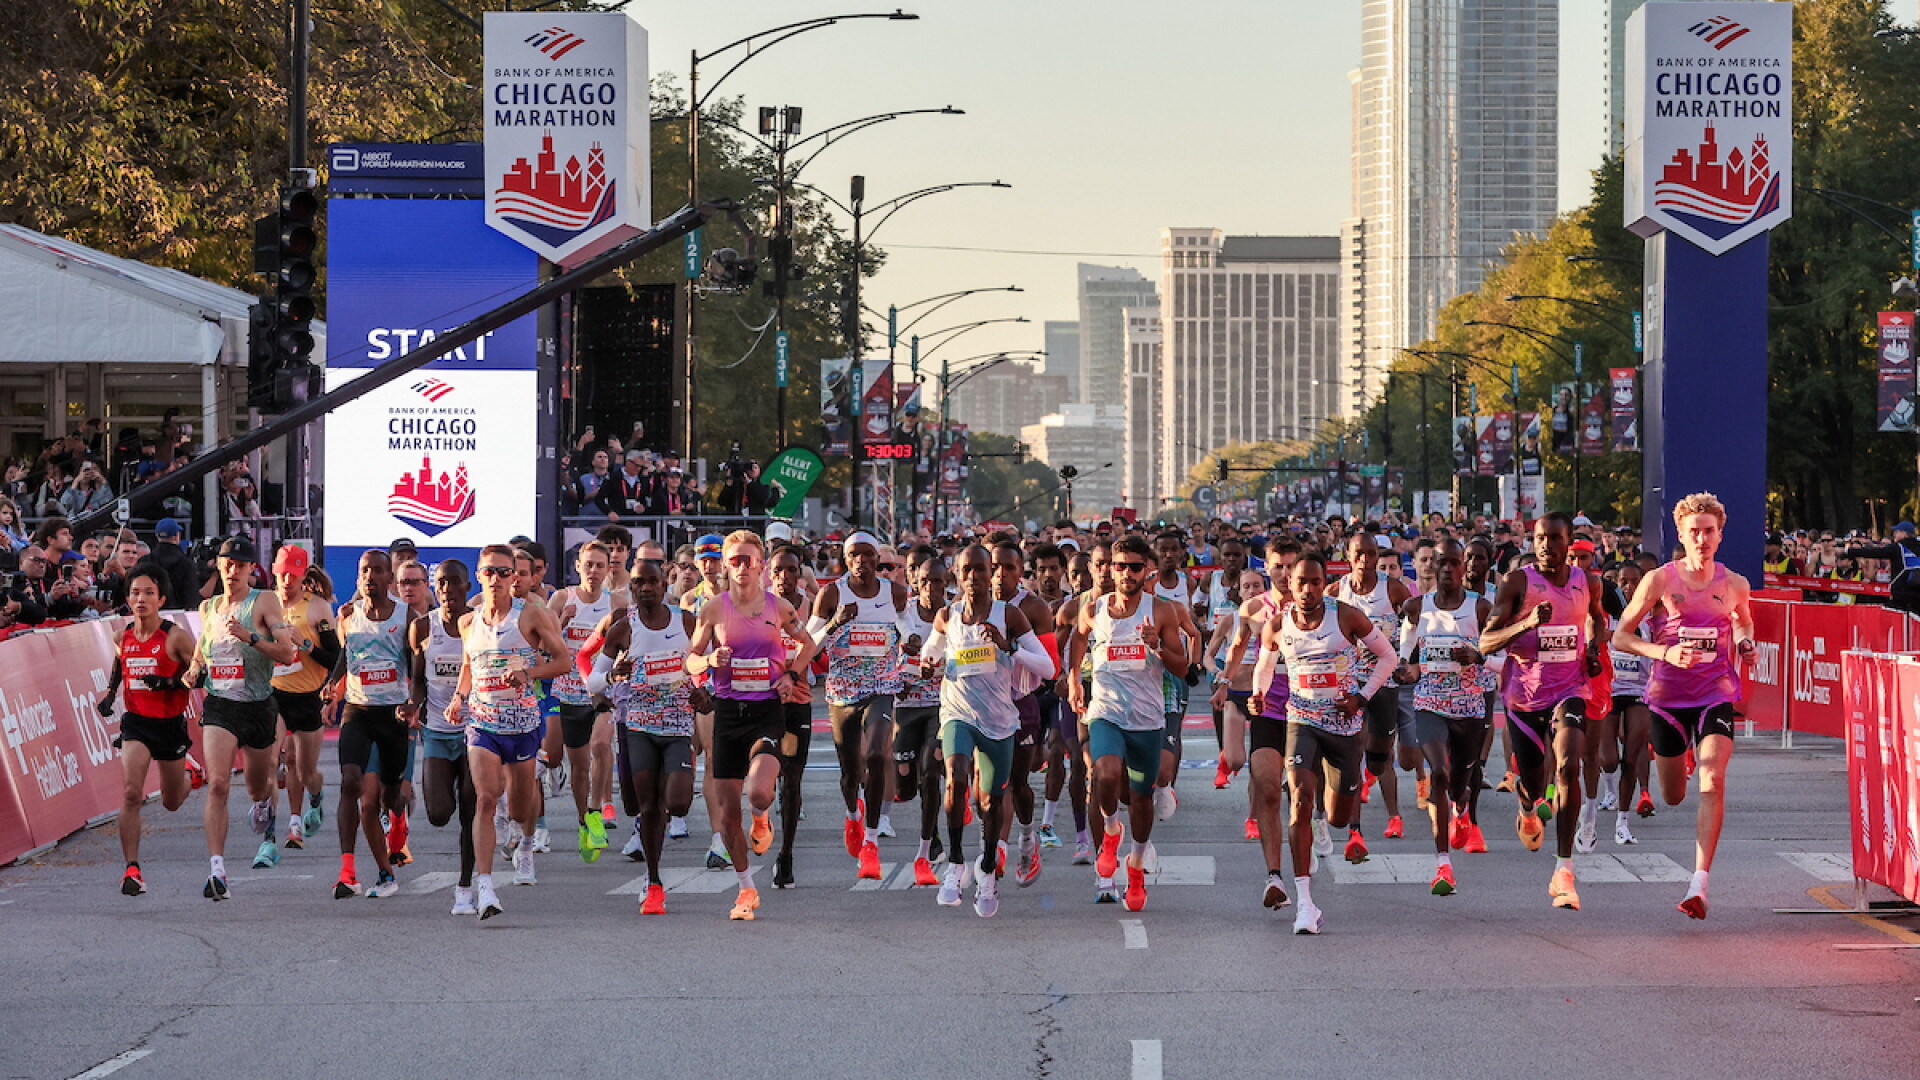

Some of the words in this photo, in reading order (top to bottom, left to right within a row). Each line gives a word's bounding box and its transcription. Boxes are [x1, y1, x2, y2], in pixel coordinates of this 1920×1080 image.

[1656, 57, 1693, 67] BANK
[1697, 57, 1715, 67] OF
[1718, 57, 1781, 67] AMERICA
[494, 68, 530, 77] BANK
[535, 68, 551, 77] OF
[555, 68, 615, 77] AMERICA
[1655, 73, 1781, 96] CHICAGO
[494, 83, 616, 105] CHICAGO
[1656, 100, 1781, 118] MARATHON
[494, 109, 616, 127] MARATHON
[361, 152, 392, 160] ABBOTT
[434, 161, 465, 169] MAJORS
[776, 335, 788, 382] C131
[389, 407, 415, 415] BANK
[417, 407, 430, 415] OF
[431, 407, 476, 415] AMERICA
[388, 418, 477, 435] CHICAGO
[388, 437, 477, 450] MARATHON
[783, 455, 811, 471] ALERT
[780, 465, 807, 481] LEVEL
[1199, 487, 1211, 503] C
[850, 632, 885, 642] EBENYO
[1541, 637, 1567, 649] PACE
[1570, 636, 1577, 647] 2
[1706, 639, 1716, 649] 17
[959, 647, 991, 660] KORIR
[1111, 647, 1140, 657] TALBI
[129, 667, 156, 676] INOUE
[215, 666, 239, 676] FORD
[1793, 635, 1813, 702] tcs
[367, 670, 390, 682] ABDI
[1306, 674, 1328, 684] ESA
[65, 679, 113, 767] tcs
